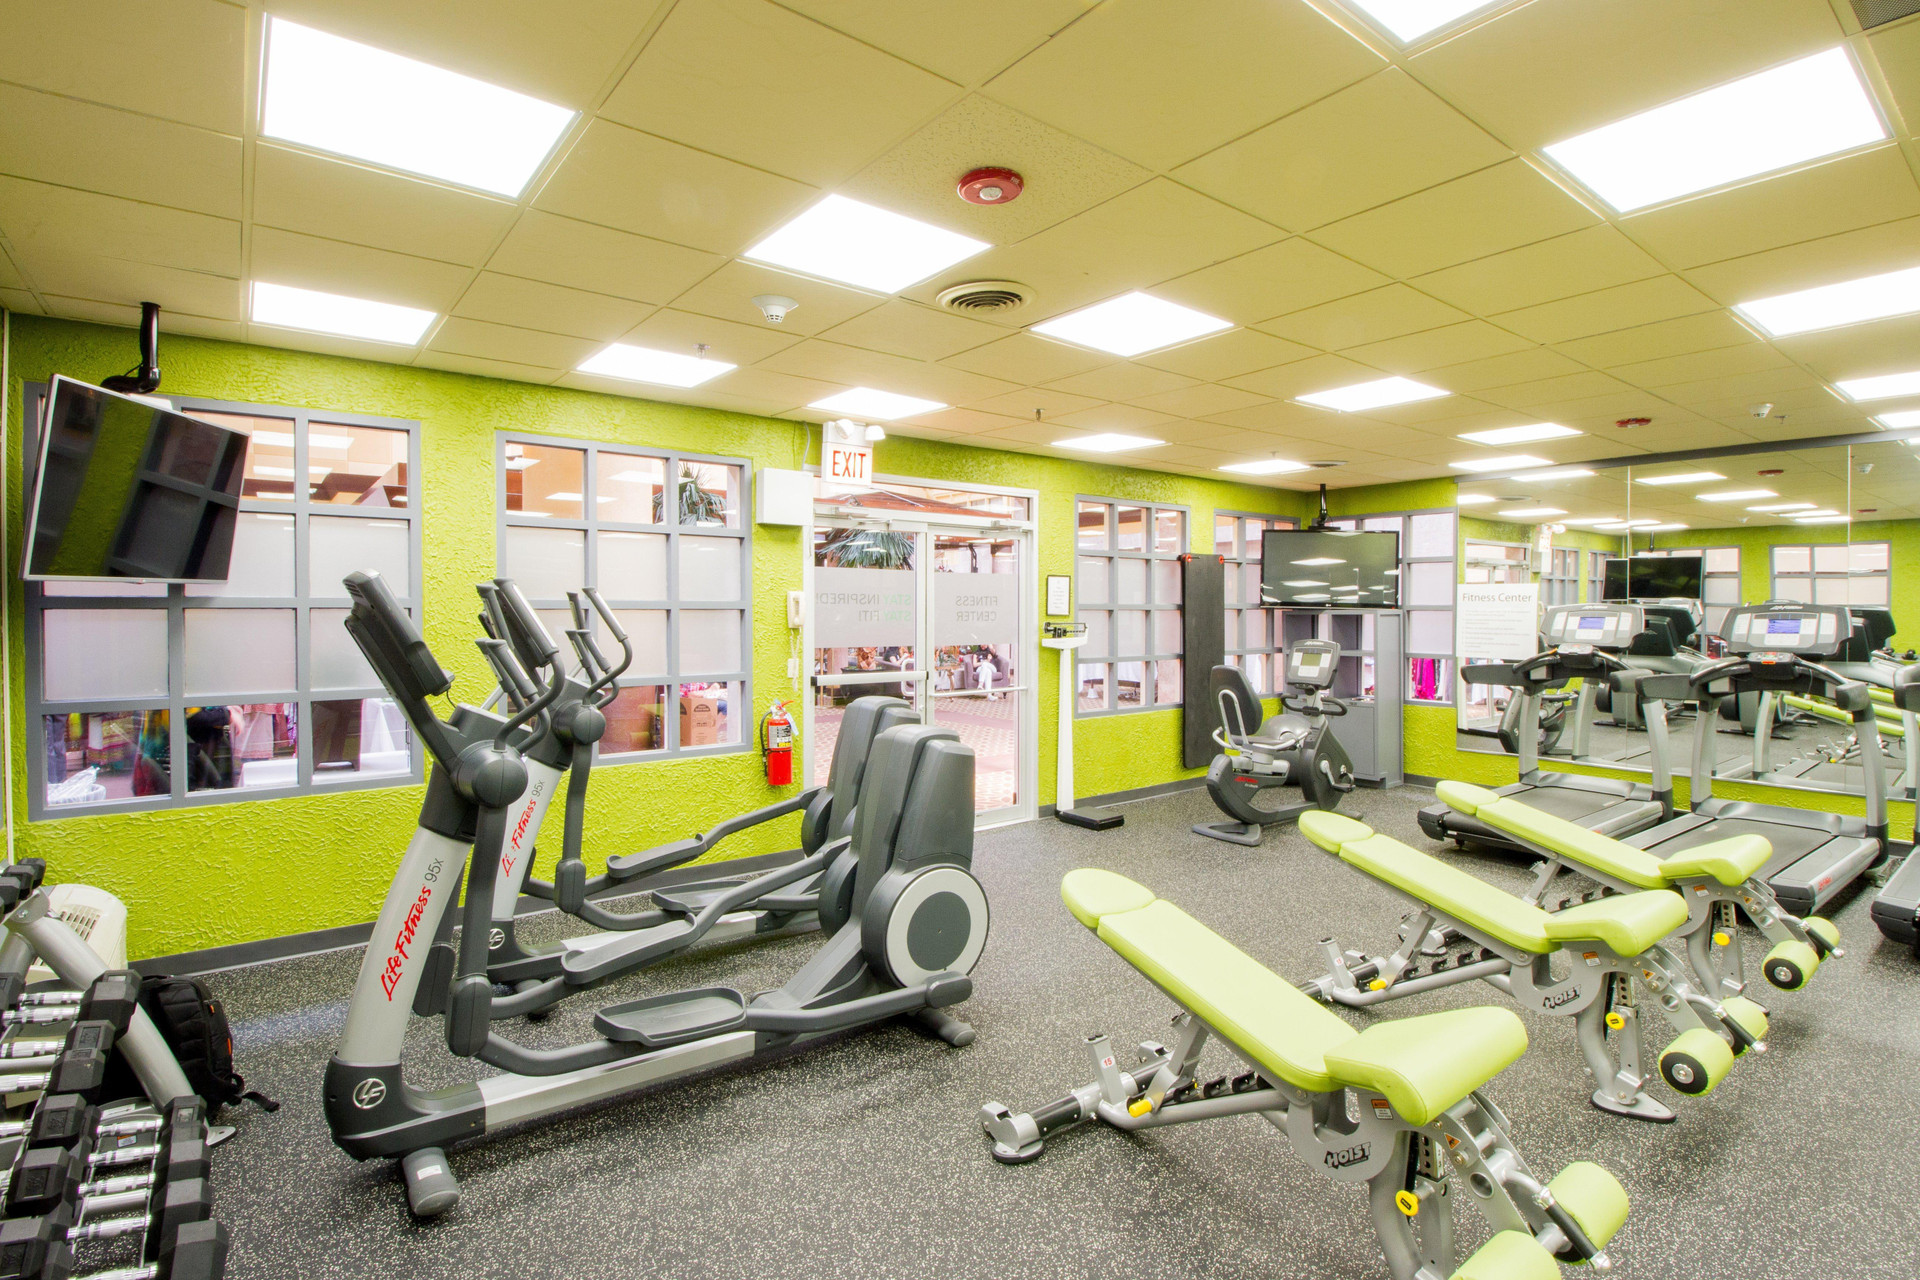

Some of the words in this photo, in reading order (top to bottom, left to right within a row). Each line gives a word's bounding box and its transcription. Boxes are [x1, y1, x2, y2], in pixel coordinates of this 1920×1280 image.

[832, 450, 867, 478] EXIT
[1462, 593, 1496, 602] Fitness
[1498, 593, 1533, 602] Center
[424, 858, 444, 882] 95x
[1542, 984, 1582, 1010] HOIST
[1323, 1141, 1371, 1169] HOIST
